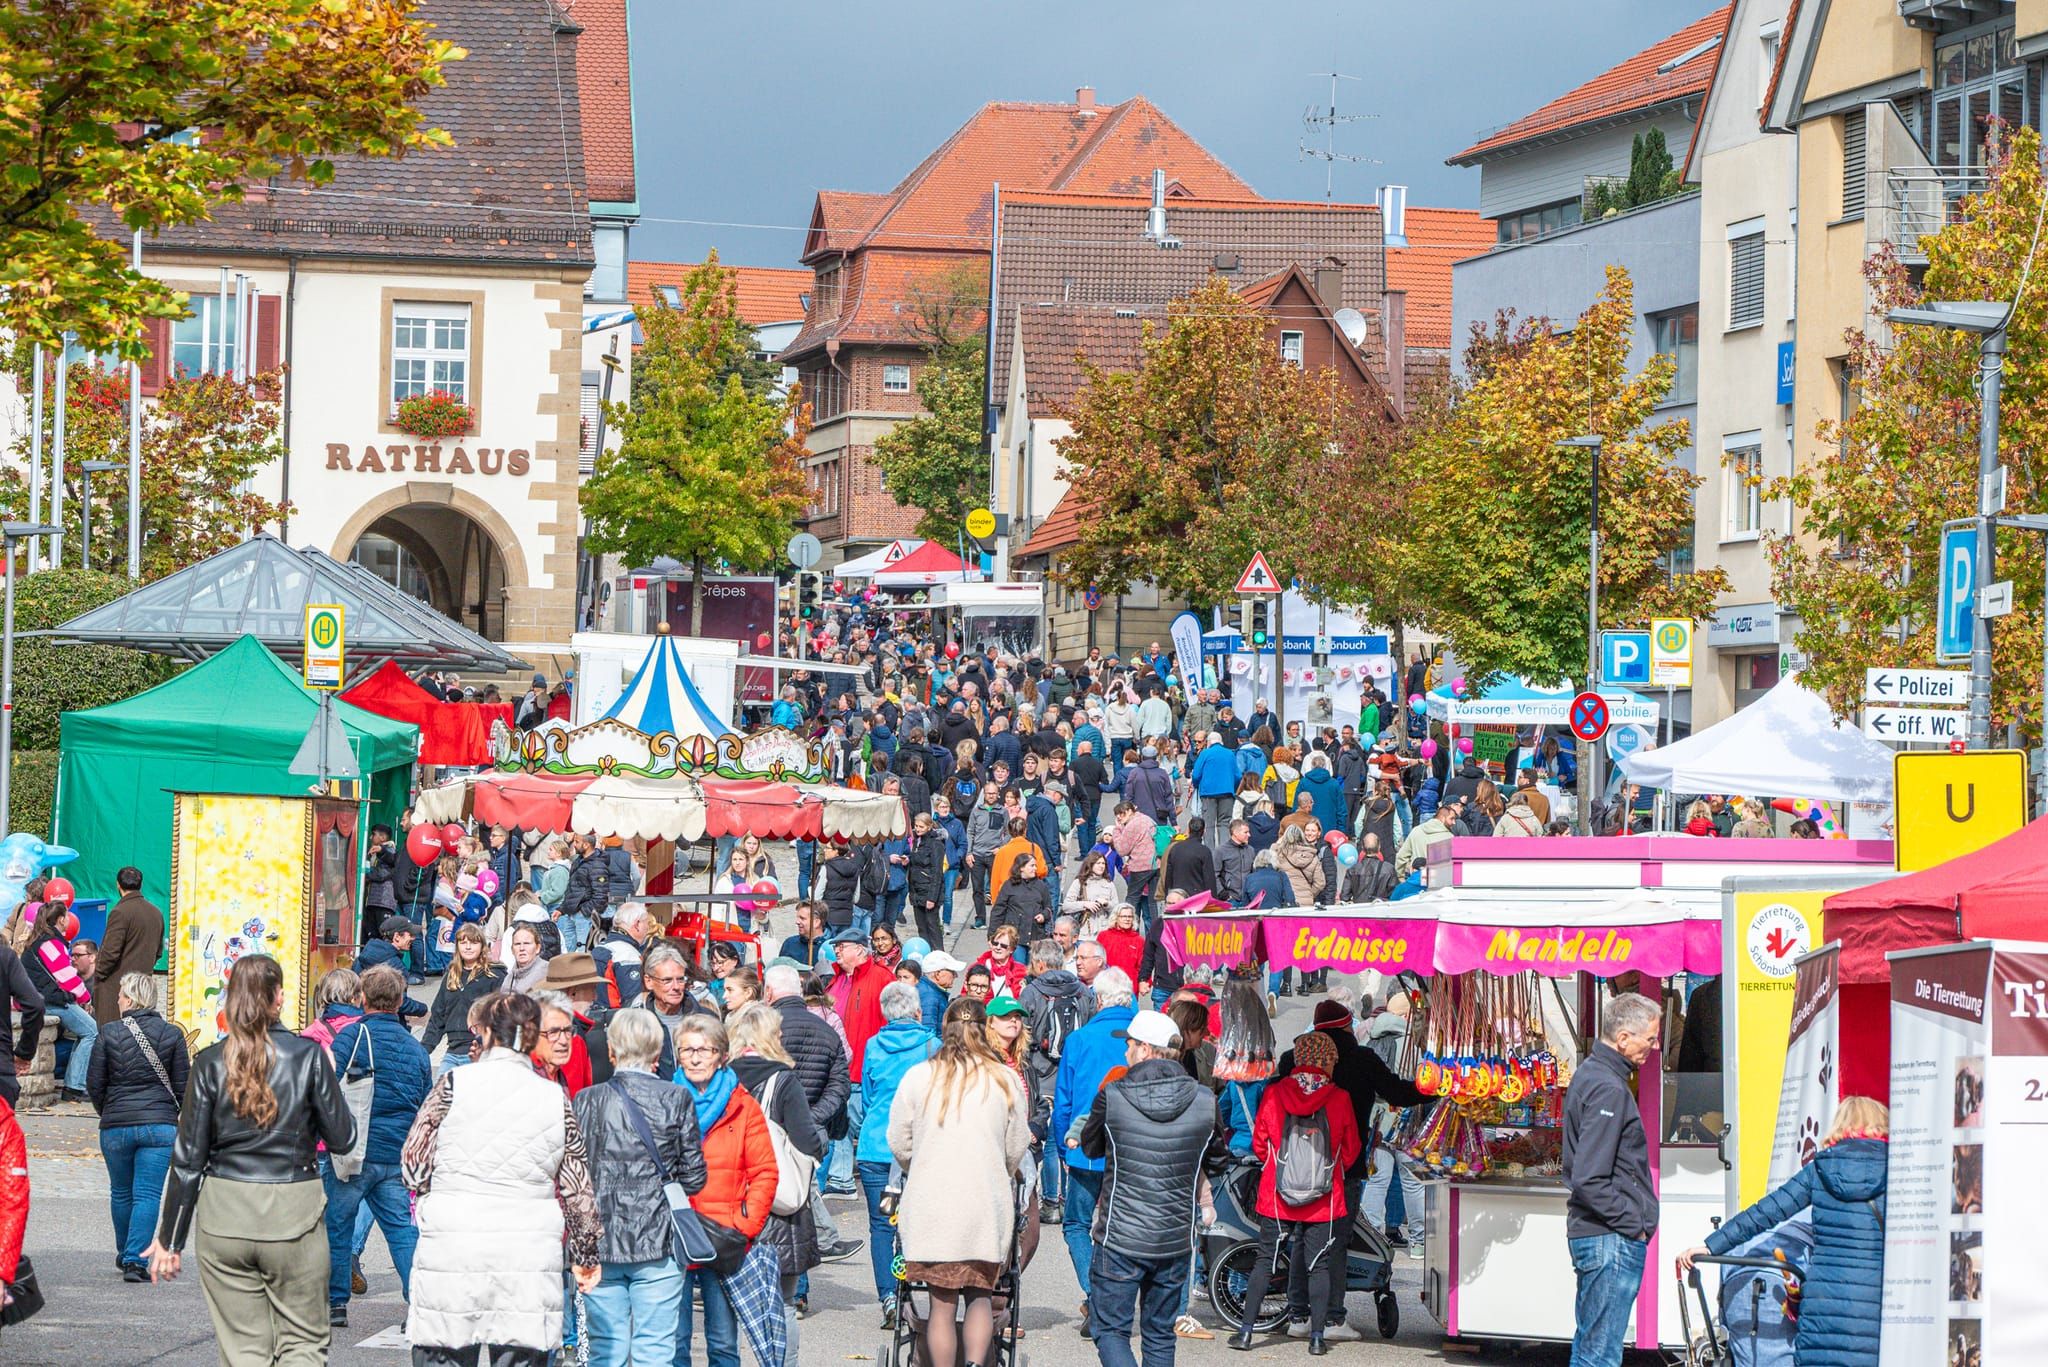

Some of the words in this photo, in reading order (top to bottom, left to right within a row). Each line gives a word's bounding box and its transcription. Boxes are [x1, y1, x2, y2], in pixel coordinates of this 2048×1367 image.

[325, 442, 531, 477] RATHAUS
[1949, 546, 1972, 639] P
[319, 619, 331, 641] H
[1664, 629, 1679, 647] H
[1331, 640, 1367, 650] önbuch
[1613, 640, 1639, 677] P
[1899, 675, 1954, 697] Polizei
[1454, 703, 1515, 717] Vorsorge.
[1897, 715, 1925, 736] öff.
[1931, 716, 1956, 736] WC
[1946, 783, 1975, 823] U
[1751, 907, 1805, 932] Tierrettung
[1185, 922, 1244, 957] Mandeln
[1293, 926, 1408, 963] Erdnüsse
[1485, 928, 1633, 962] Mandeln
[1740, 982, 1796, 991] TIERRETTUN
[1915, 978, 1931, 999] Die
[1932, 982, 1983, 1017] Tierrettung
